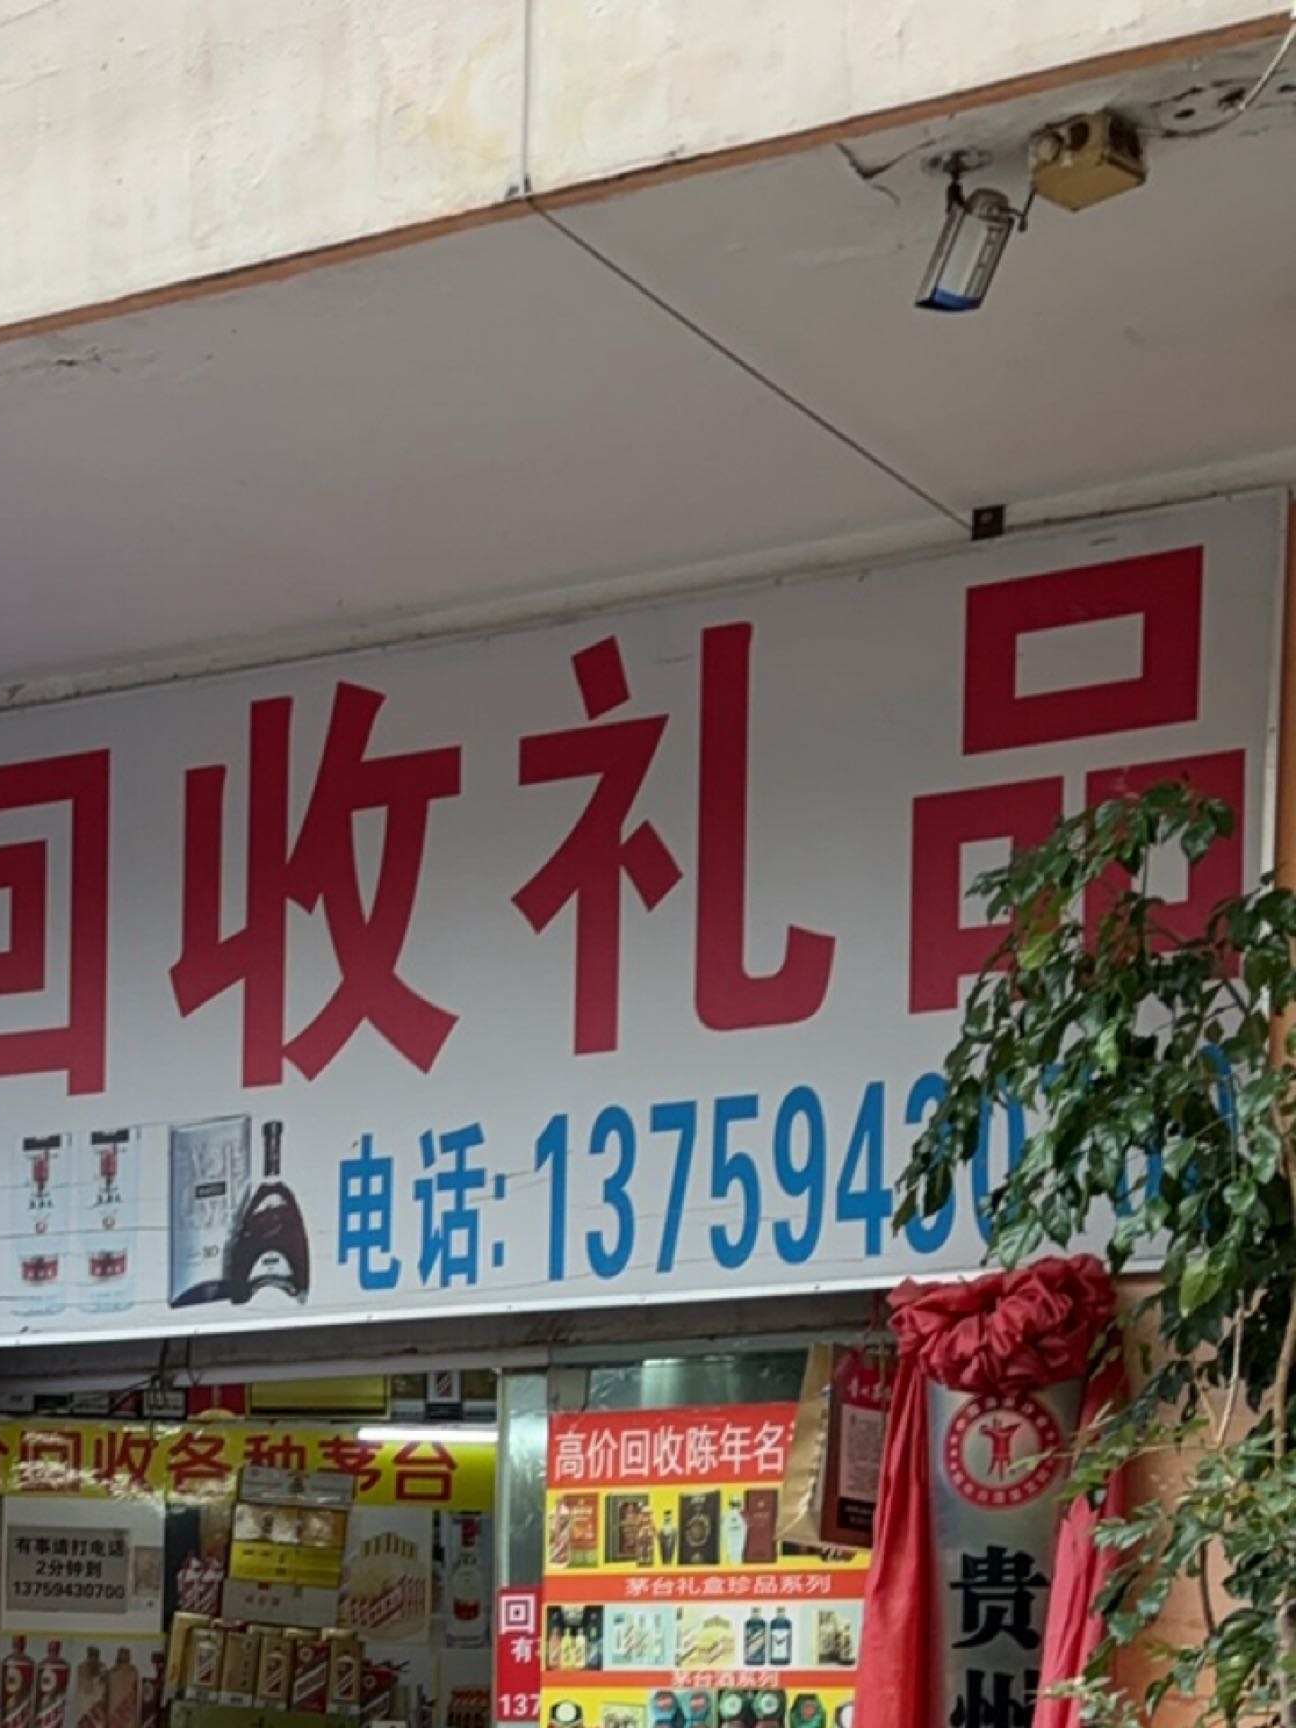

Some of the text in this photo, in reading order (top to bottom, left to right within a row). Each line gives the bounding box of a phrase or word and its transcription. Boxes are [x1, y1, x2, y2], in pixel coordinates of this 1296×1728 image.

[554, 1421, 795, 1481] 高价回收陈年名
[12, 1581, 125, 1600] 13759430700
[624, 1573, 832, 1598] 茅台礼盒珍品系列
[499, 1593, 536, 1635] 回
[510, 1637, 541, 1663] 有
